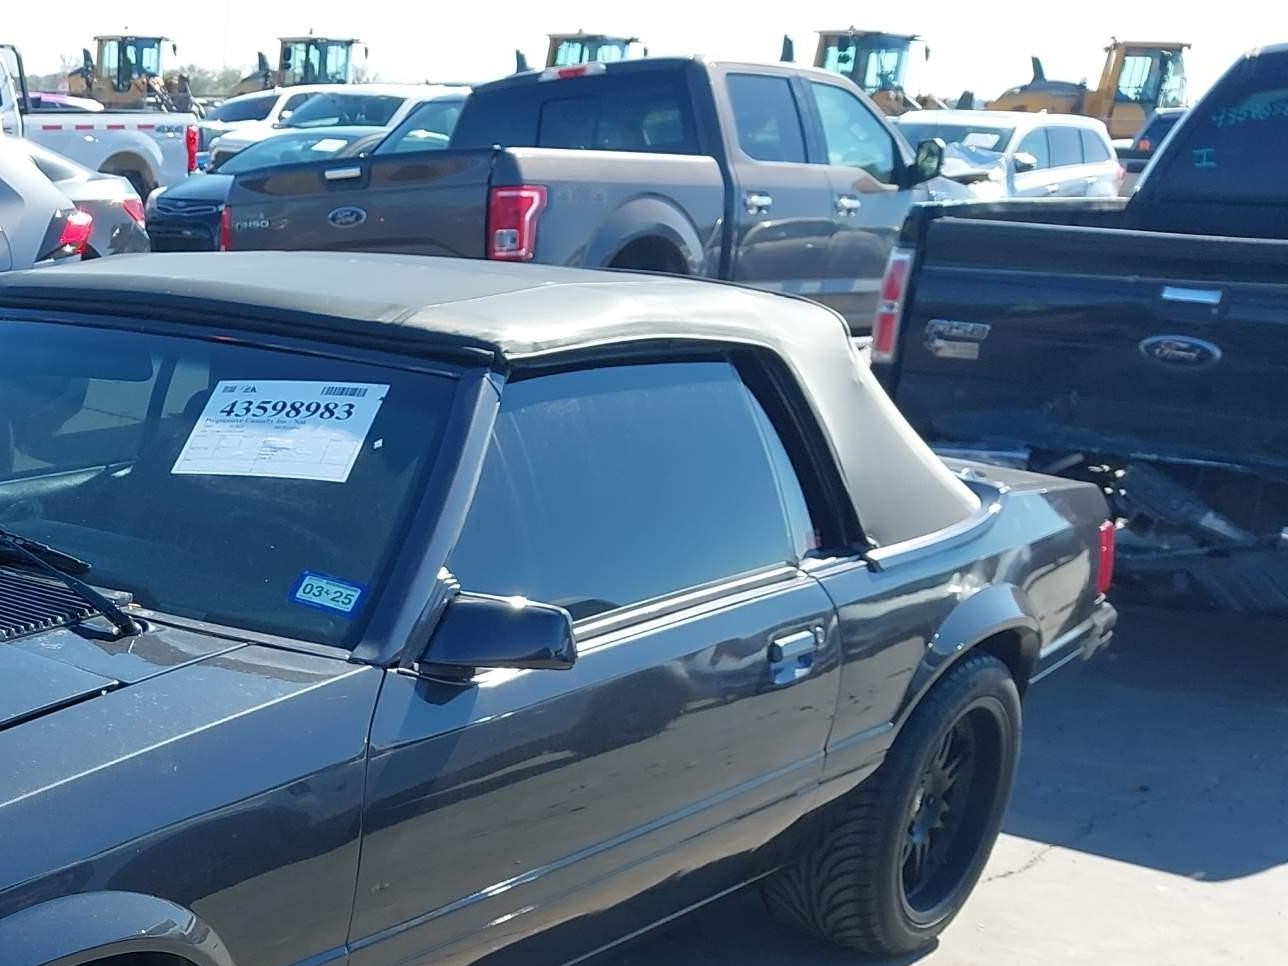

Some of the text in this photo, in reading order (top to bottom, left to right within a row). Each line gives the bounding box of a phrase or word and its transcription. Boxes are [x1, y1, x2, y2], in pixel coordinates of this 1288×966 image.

[219, 399, 356, 421] 43598983
[302, 582, 355, 606] 03 25
